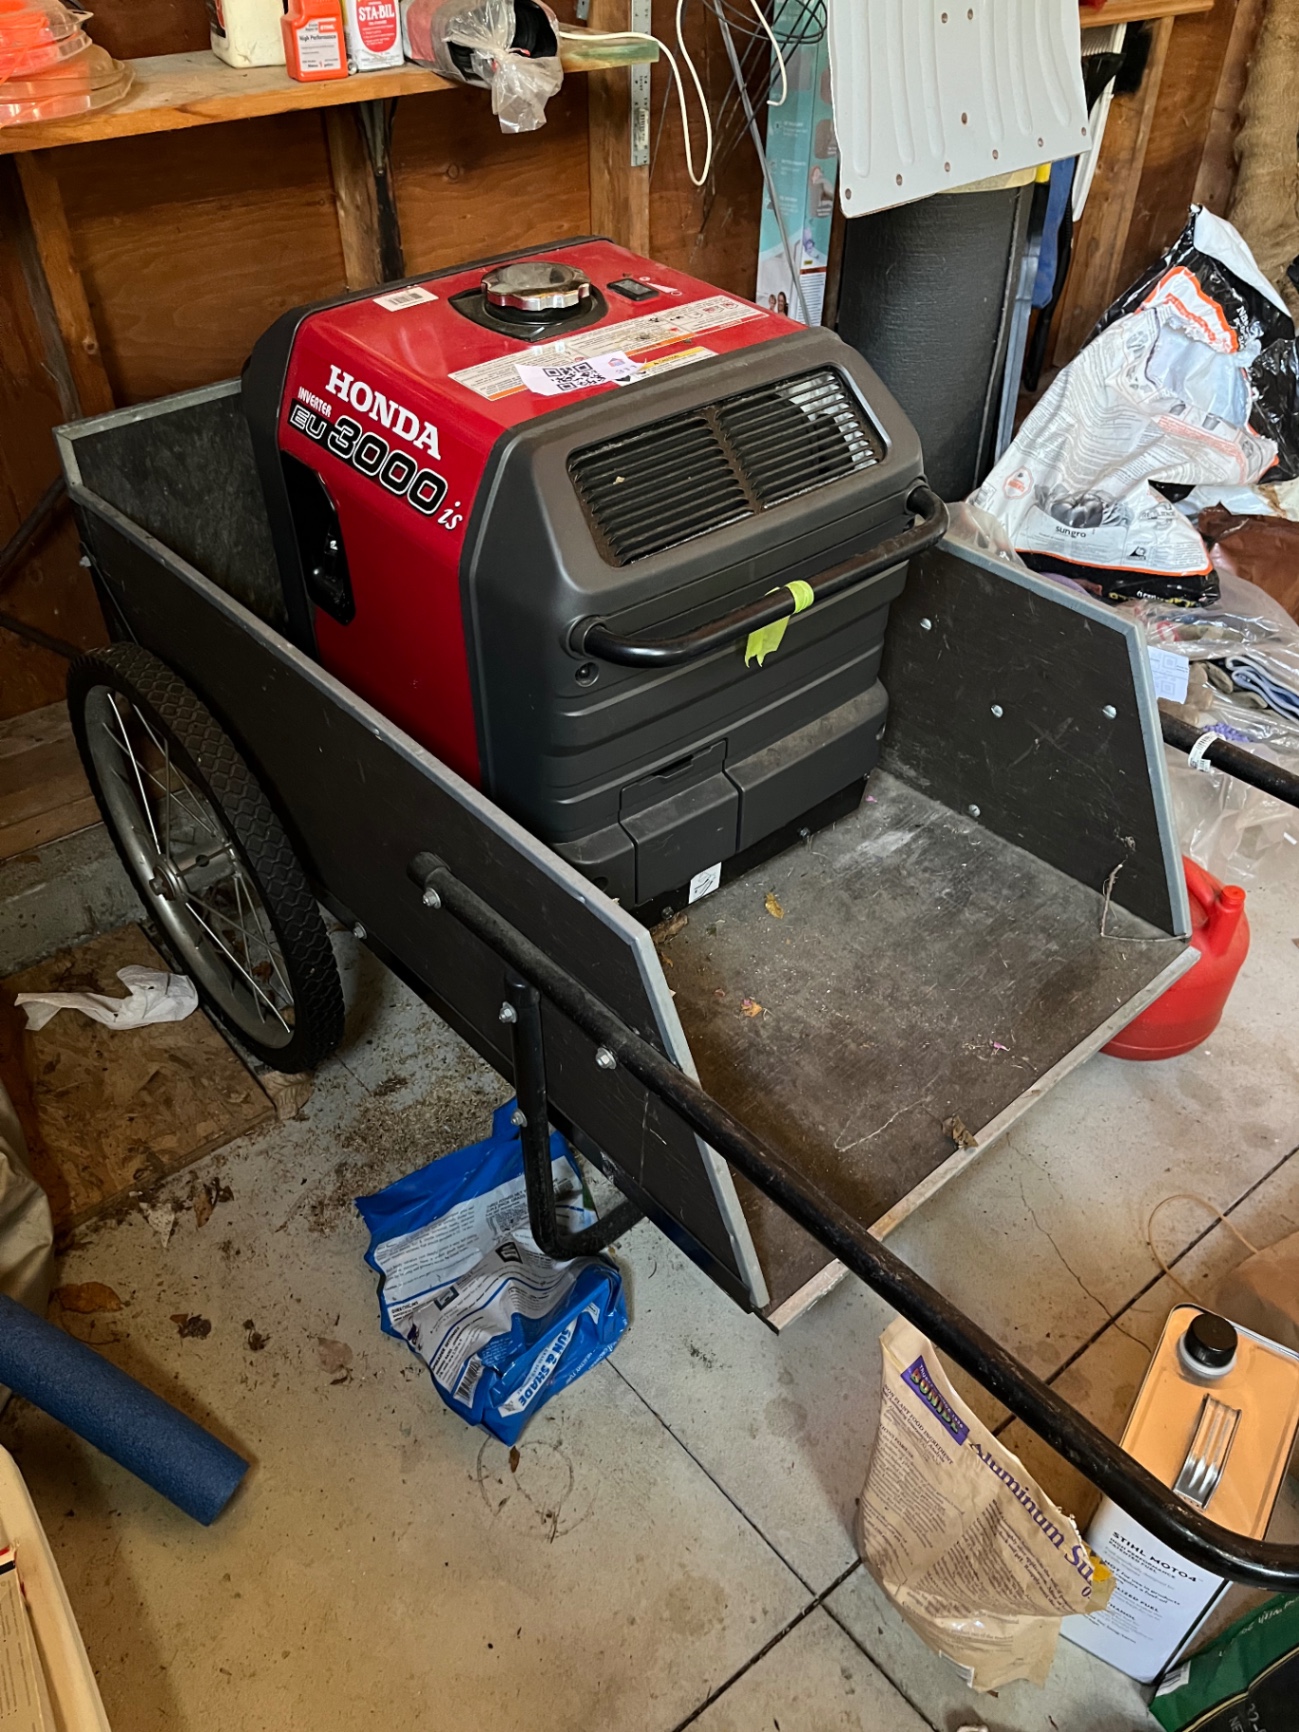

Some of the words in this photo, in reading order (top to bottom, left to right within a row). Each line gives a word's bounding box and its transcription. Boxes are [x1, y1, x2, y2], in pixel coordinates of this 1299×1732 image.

[358, 4, 394, 22] STA-BIL
[298, 386, 332, 418] INVERTER
[325, 364, 441, 460] HONDA
[552, 1329, 571, 1353] SUN
[546, 1353, 557, 1365] &
[518, 1365, 550, 1406] SHADE
[910, 1368, 959, 1434] BONIDE
[924, 1431, 953, 1464] INGREDIENT
[970, 1443, 1065, 1549] Aluminum
[1064, 1545, 1093, 1585] Su
[1109, 1541, 1139, 1563] PATENTED
[1141, 1562, 1156, 1573] FUEL
[1110, 1538, 1126, 1550] HIGH
[1127, 1550, 1175, 1578] PERFORMANCE
[1113, 1531, 1146, 1557] STIHL
[1150, 1556, 1196, 1581] MOTO4
[1140, 1601, 1158, 1612] FUEL
[1150, 1590, 1180, 1605] products
